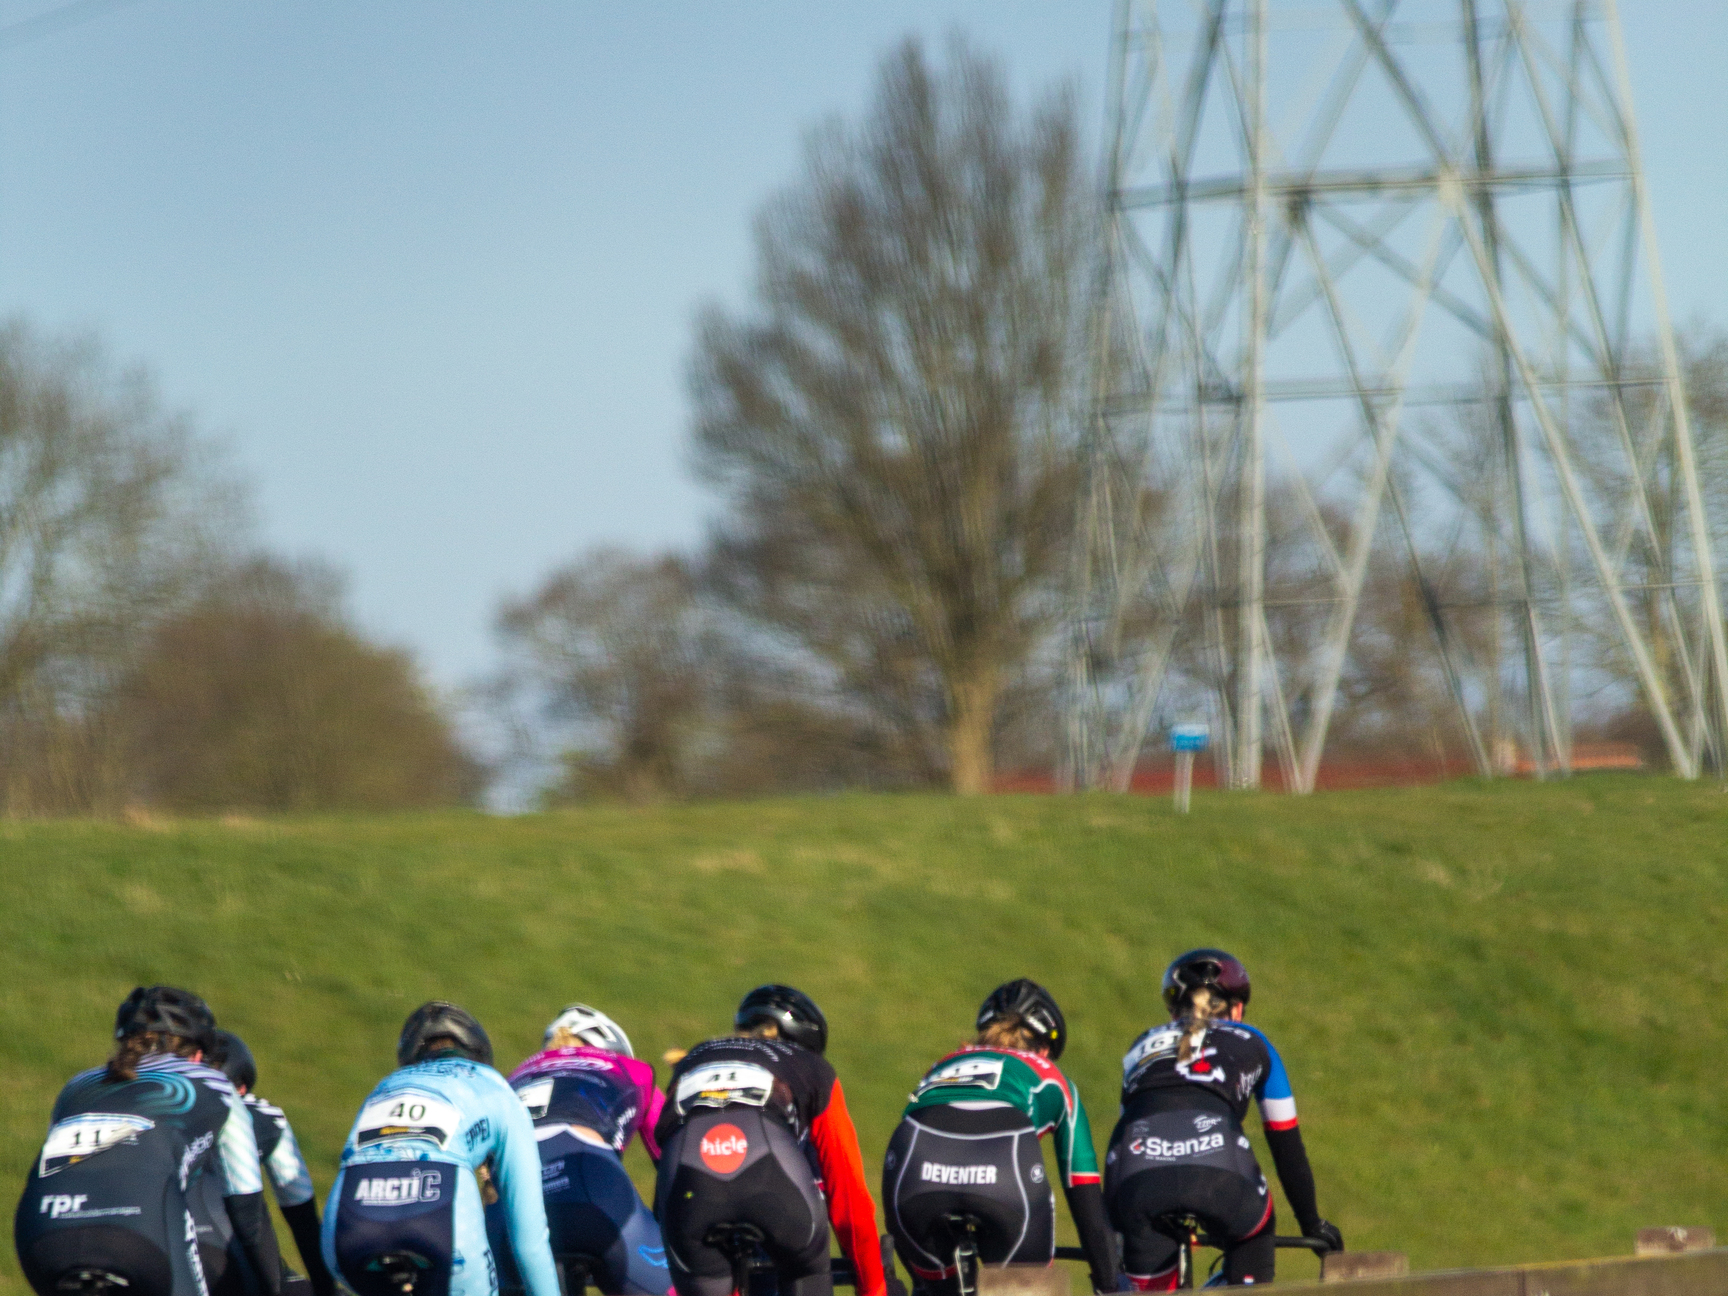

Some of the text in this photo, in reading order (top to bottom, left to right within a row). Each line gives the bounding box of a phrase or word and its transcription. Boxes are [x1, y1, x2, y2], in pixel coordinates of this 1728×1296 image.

[1139, 1034, 1180, 1057] 161
[389, 1101, 427, 1122] 40
[1146, 1132, 1225, 1157] Stanza
[921, 1161, 998, 1185] DEVENTER
[39, 1194, 88, 1219] rpr
